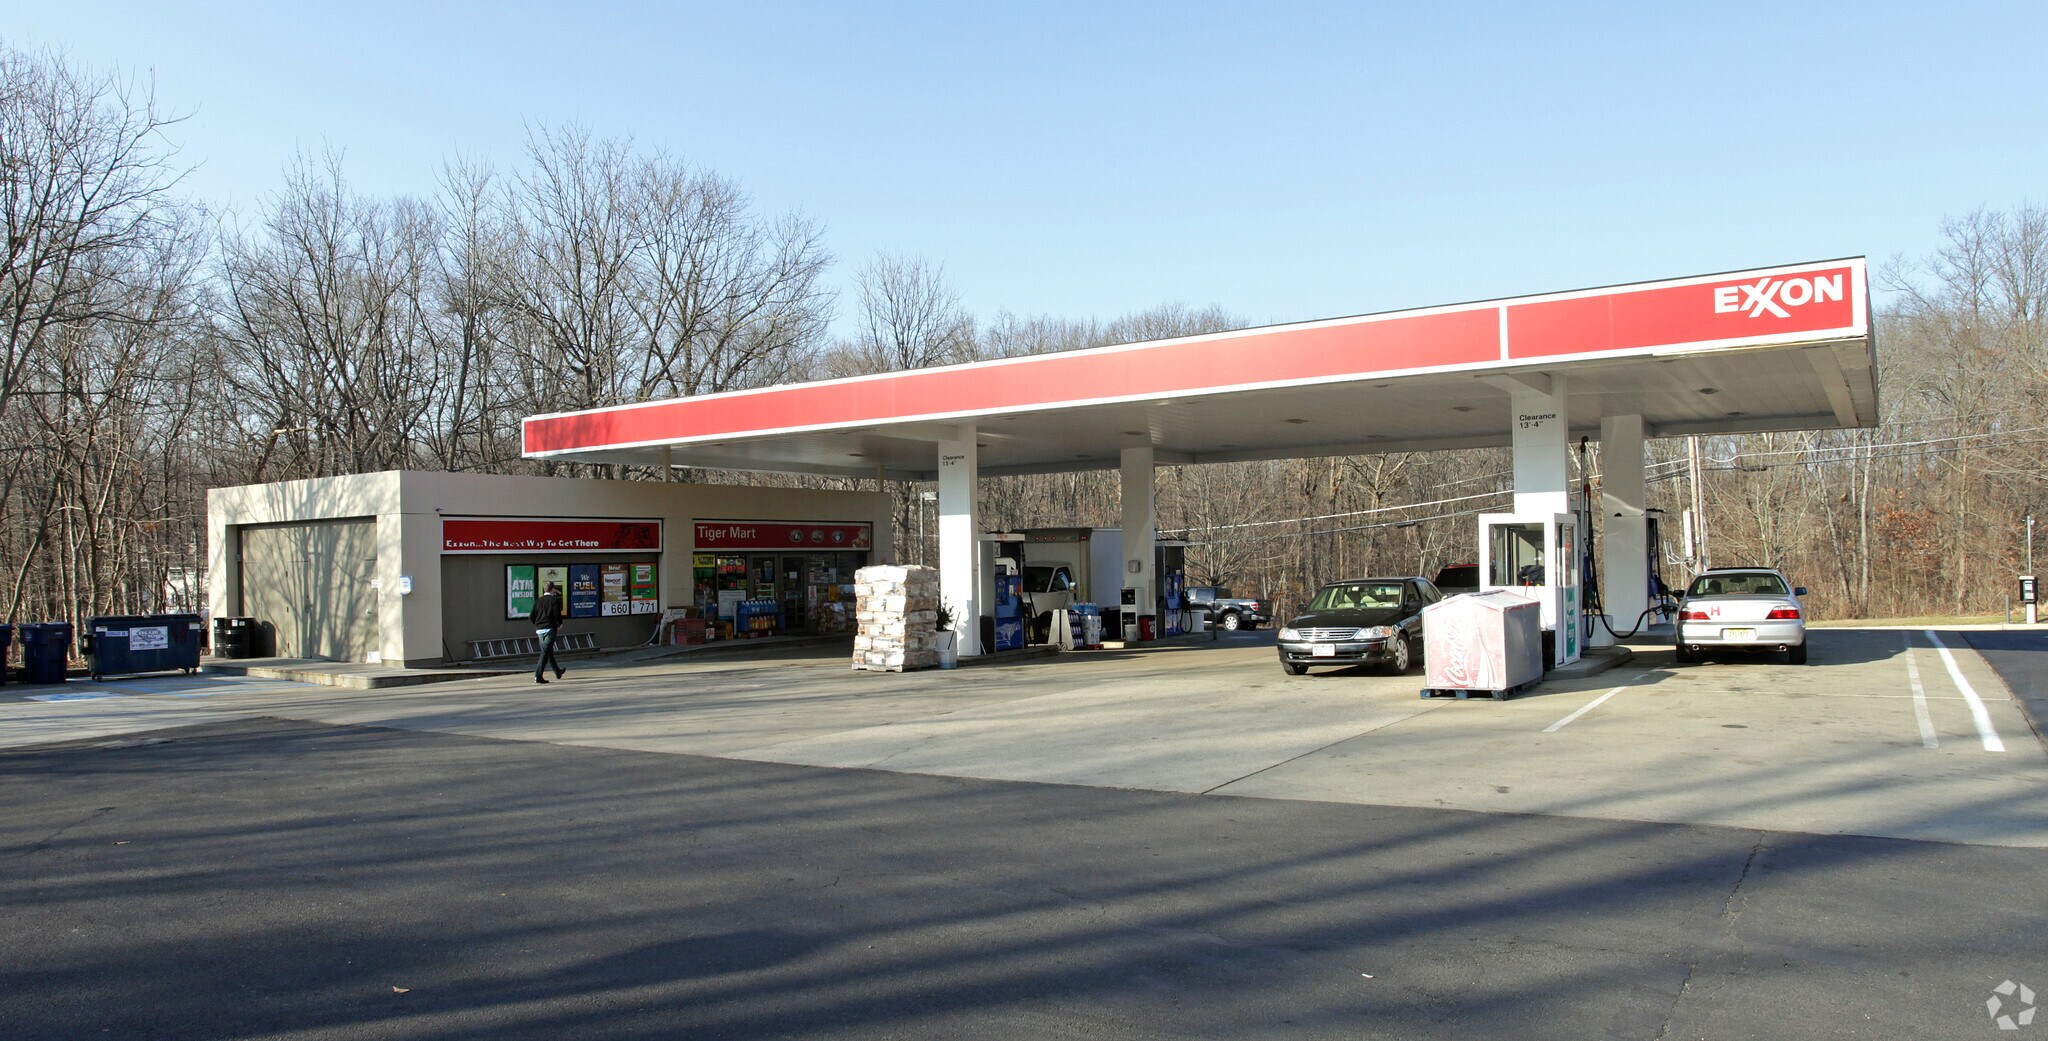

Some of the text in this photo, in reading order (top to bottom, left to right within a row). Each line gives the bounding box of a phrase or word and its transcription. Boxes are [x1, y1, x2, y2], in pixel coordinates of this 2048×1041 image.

[1714, 274, 1843, 318] EXXON
[697, 526, 756, 541] Tiger Mart
[512, 579, 533, 590] ATM
[573, 581, 596, 590] FUEL
[1710, 606, 1721, 616] H
